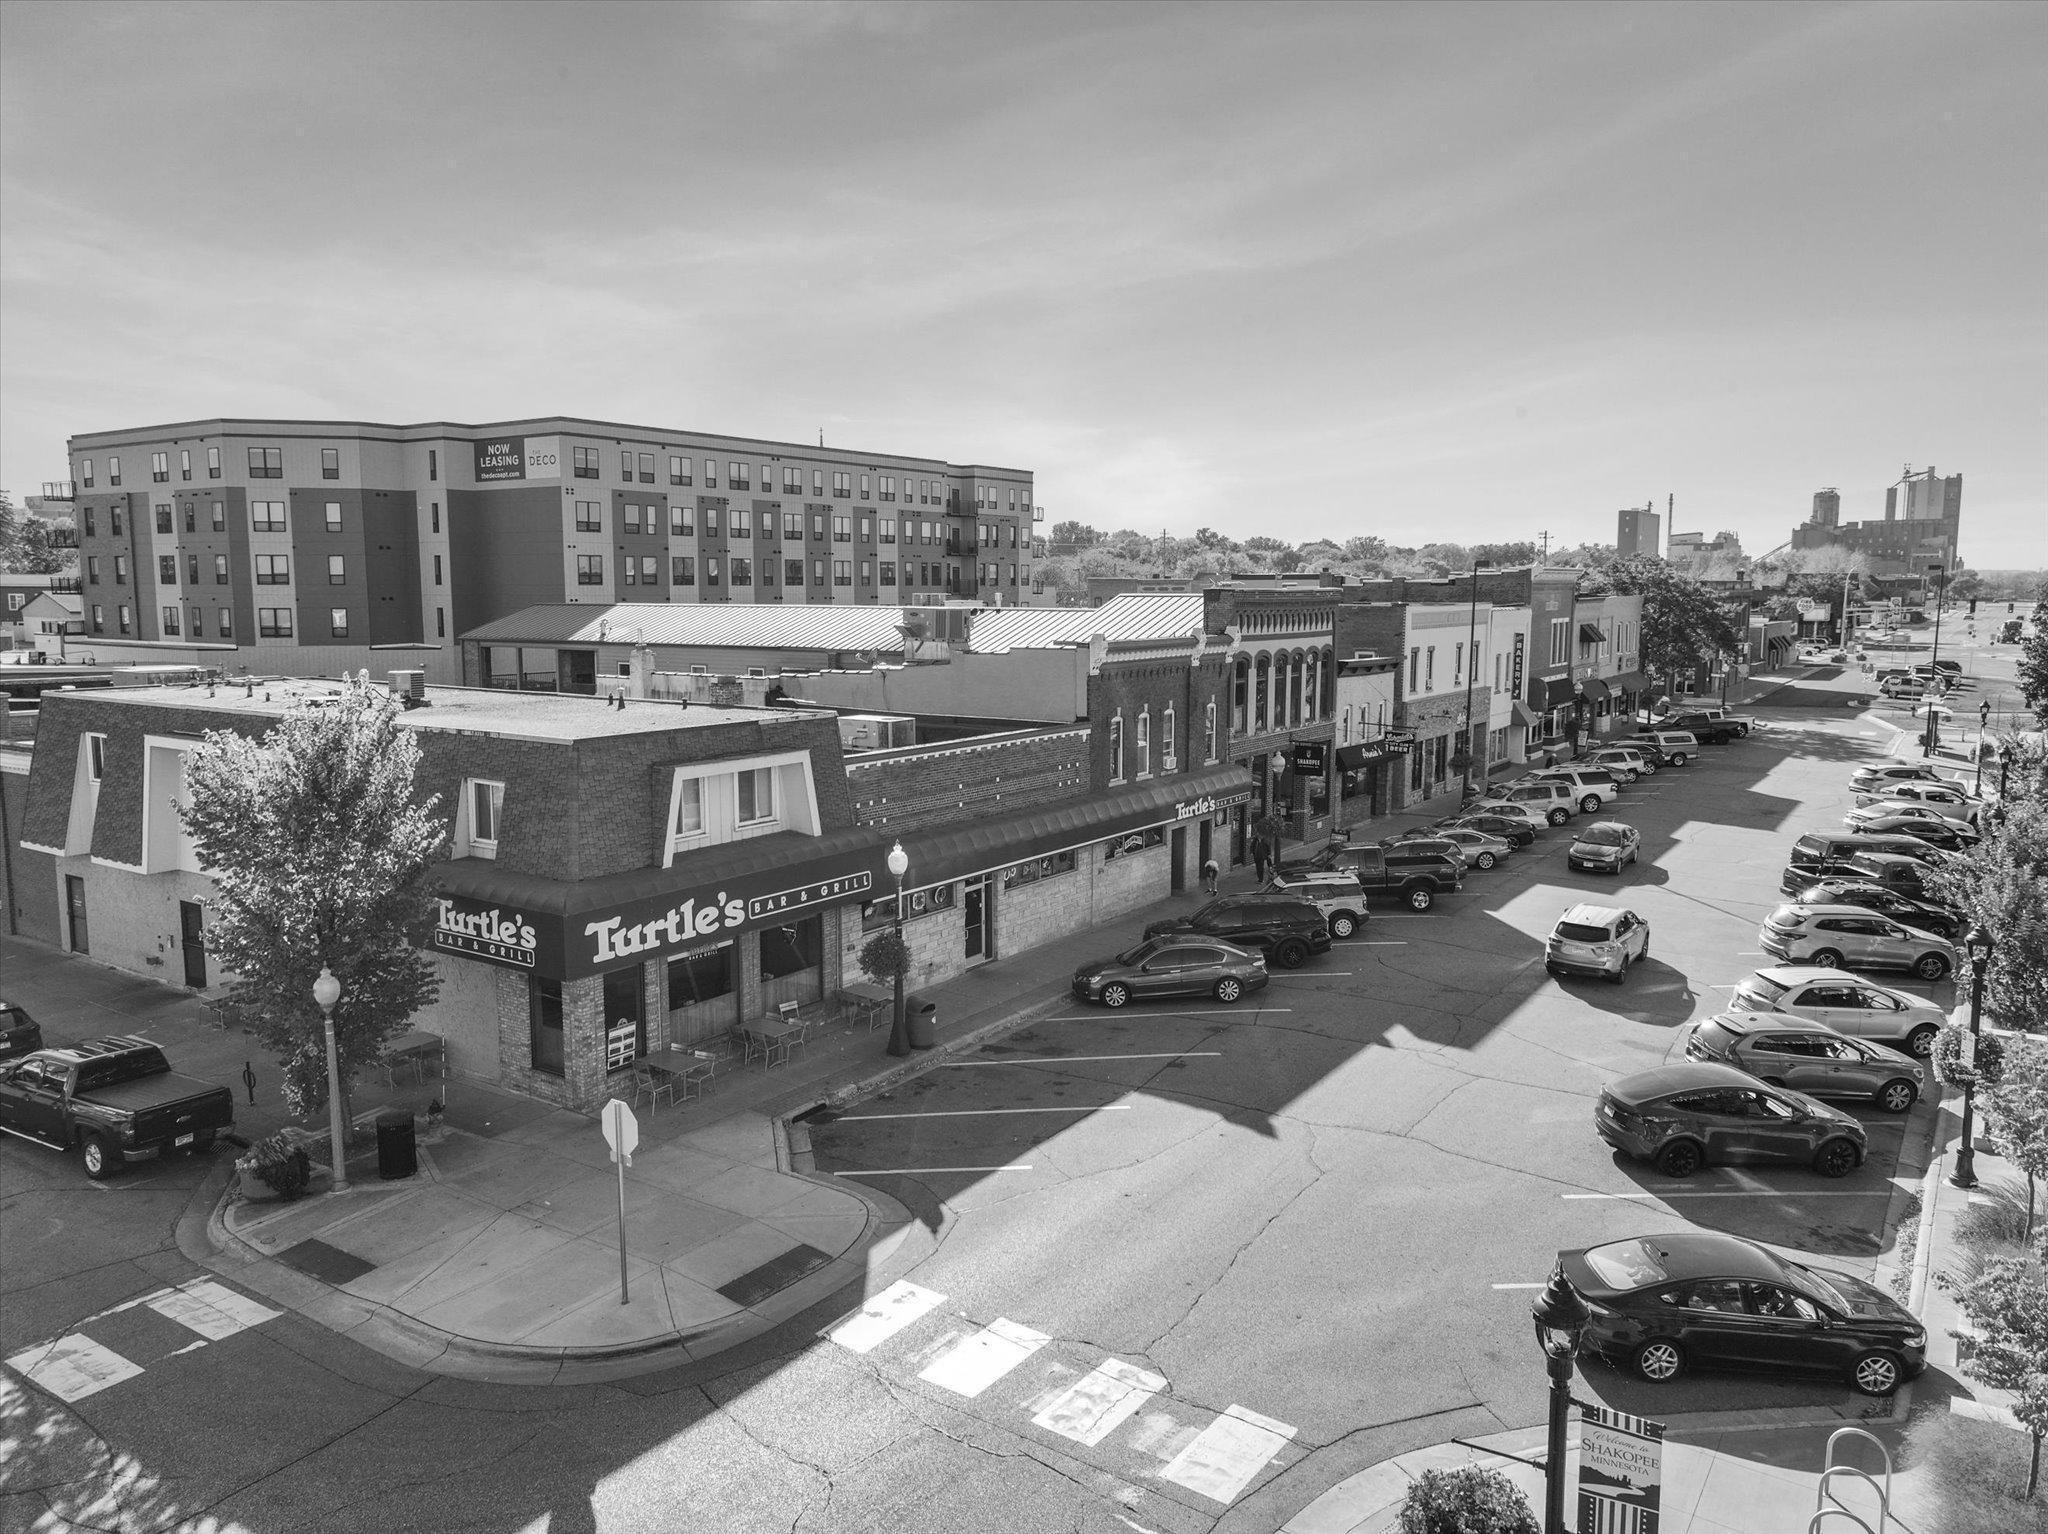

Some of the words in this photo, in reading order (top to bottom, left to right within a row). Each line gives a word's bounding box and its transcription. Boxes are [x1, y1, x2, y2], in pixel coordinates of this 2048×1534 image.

[487, 443, 510, 455] NOW
[480, 455, 519, 467] LEASING
[529, 454, 556, 466] DECO
[481, 471, 520, 479] thedecoapt.com
[1514, 642, 1522, 686] BAKERY
[1296, 758, 1321, 766] SHAKOPEE
[1175, 796, 1216, 820] Turtle's
[434, 897, 537, 949] Turtle's
[584, 891, 746, 964] Turtle's
[754, 895, 787, 914] BAR
[800, 891, 807, 902] &
[820, 876, 868, 896] GRILL
[438, 932, 463, 947] BAR
[472, 940, 479, 950] &
[489, 944, 532, 963] GRILL
[1593, 1430, 1637, 1449] Welcome
[1581, 1437, 1660, 1469] SHAKOPEE
[1590, 1455, 1650, 1476] MINNESOTA
